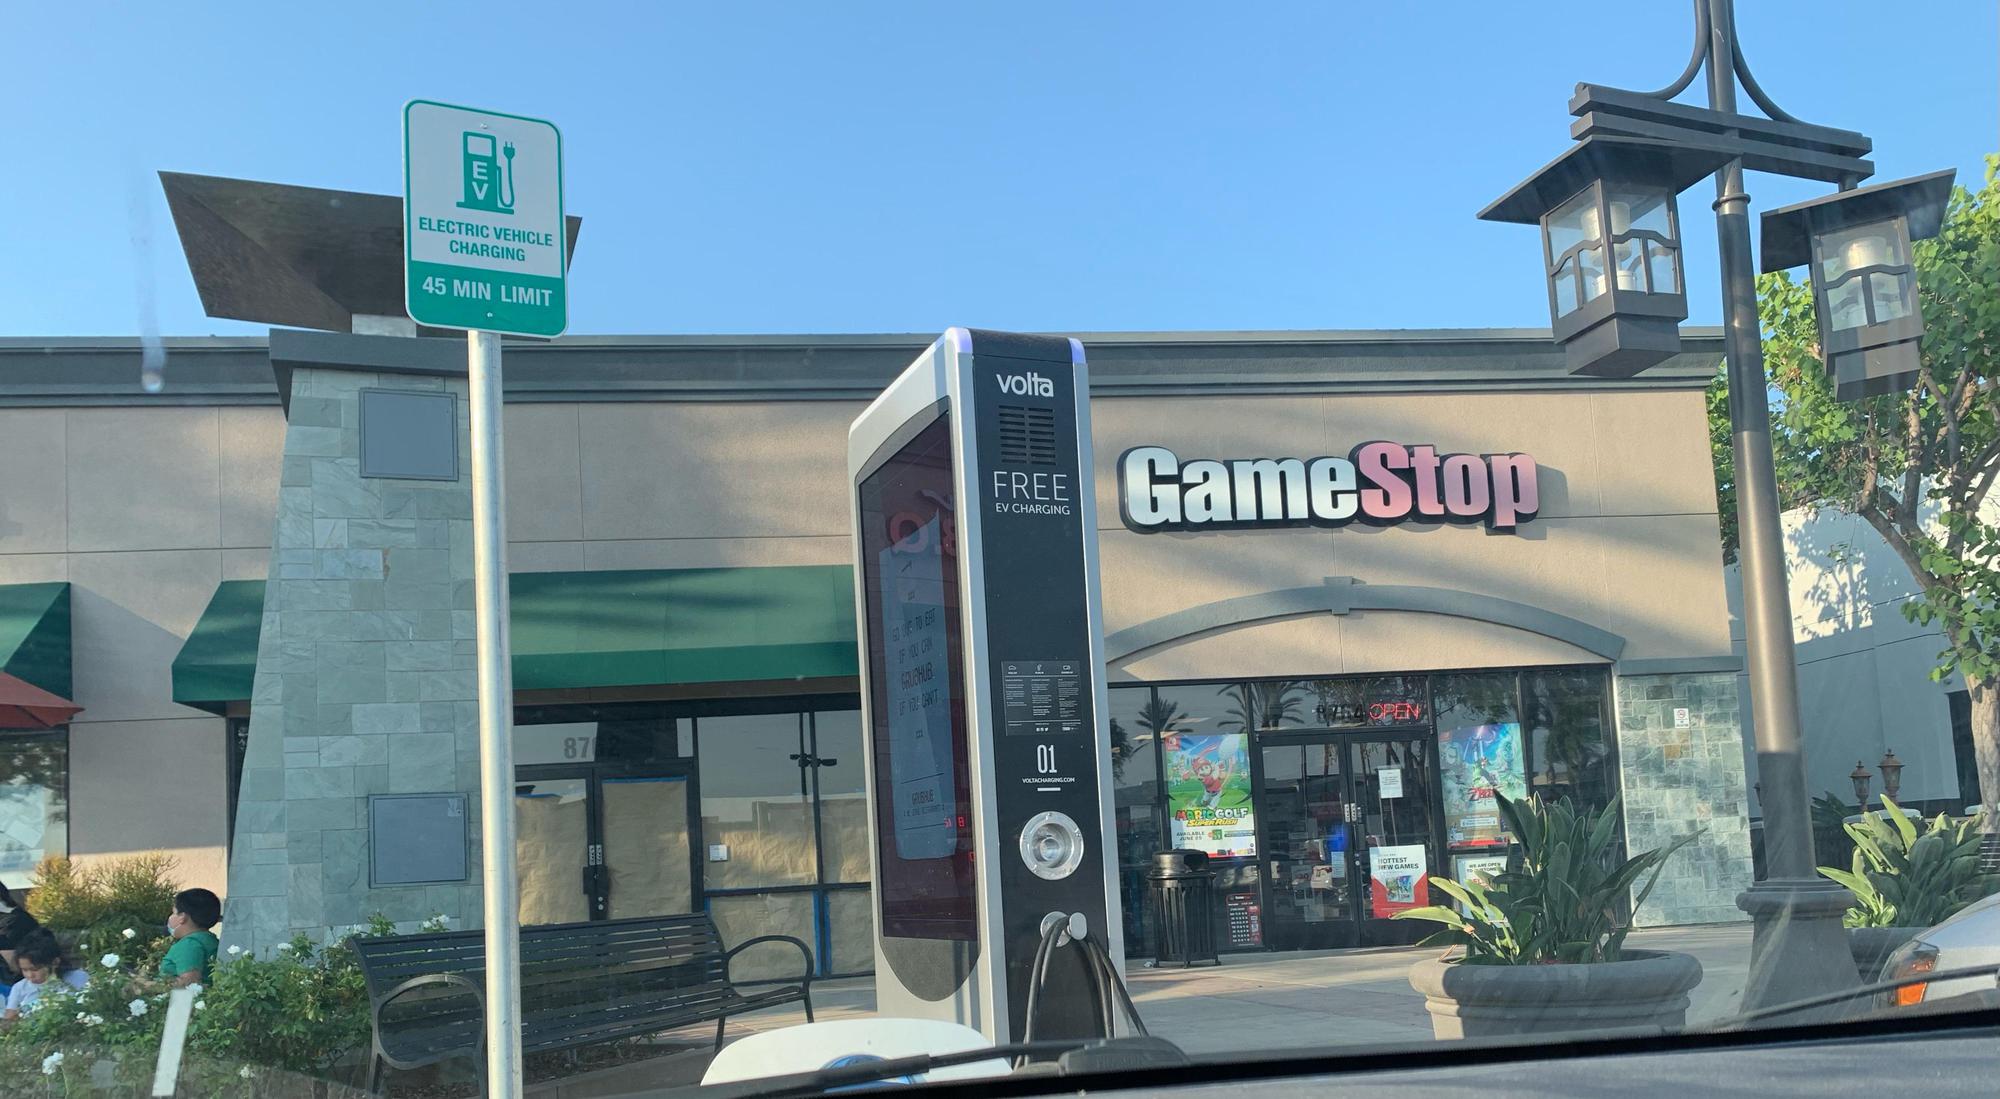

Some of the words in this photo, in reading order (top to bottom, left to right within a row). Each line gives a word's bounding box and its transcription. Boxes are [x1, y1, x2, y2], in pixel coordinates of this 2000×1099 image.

[418, 217, 490, 239] ELECTRIC
[492, 226, 553, 247] VEHICLE
[449, 240, 526, 262] CHARGING
[422, 275, 447, 295] 45
[453, 279, 491, 301] MIN
[500, 284, 553, 306] LIMIT
[996, 372, 1054, 397] volta
[993, 471, 1069, 501] FREE
[1117, 440, 1539, 534] GameStop
[995, 502, 1009, 513] EV
[1012, 503, 1071, 515] CHARGING
[1369, 703, 1420, 720] OPEN
[563, 737, 596, 759] 87
[1036, 744, 1058, 774] 01
[1175, 808, 1215, 821] MARIO
[1215, 807, 1248, 819] GOLF
[1215, 818, 1238, 826] RUSH
